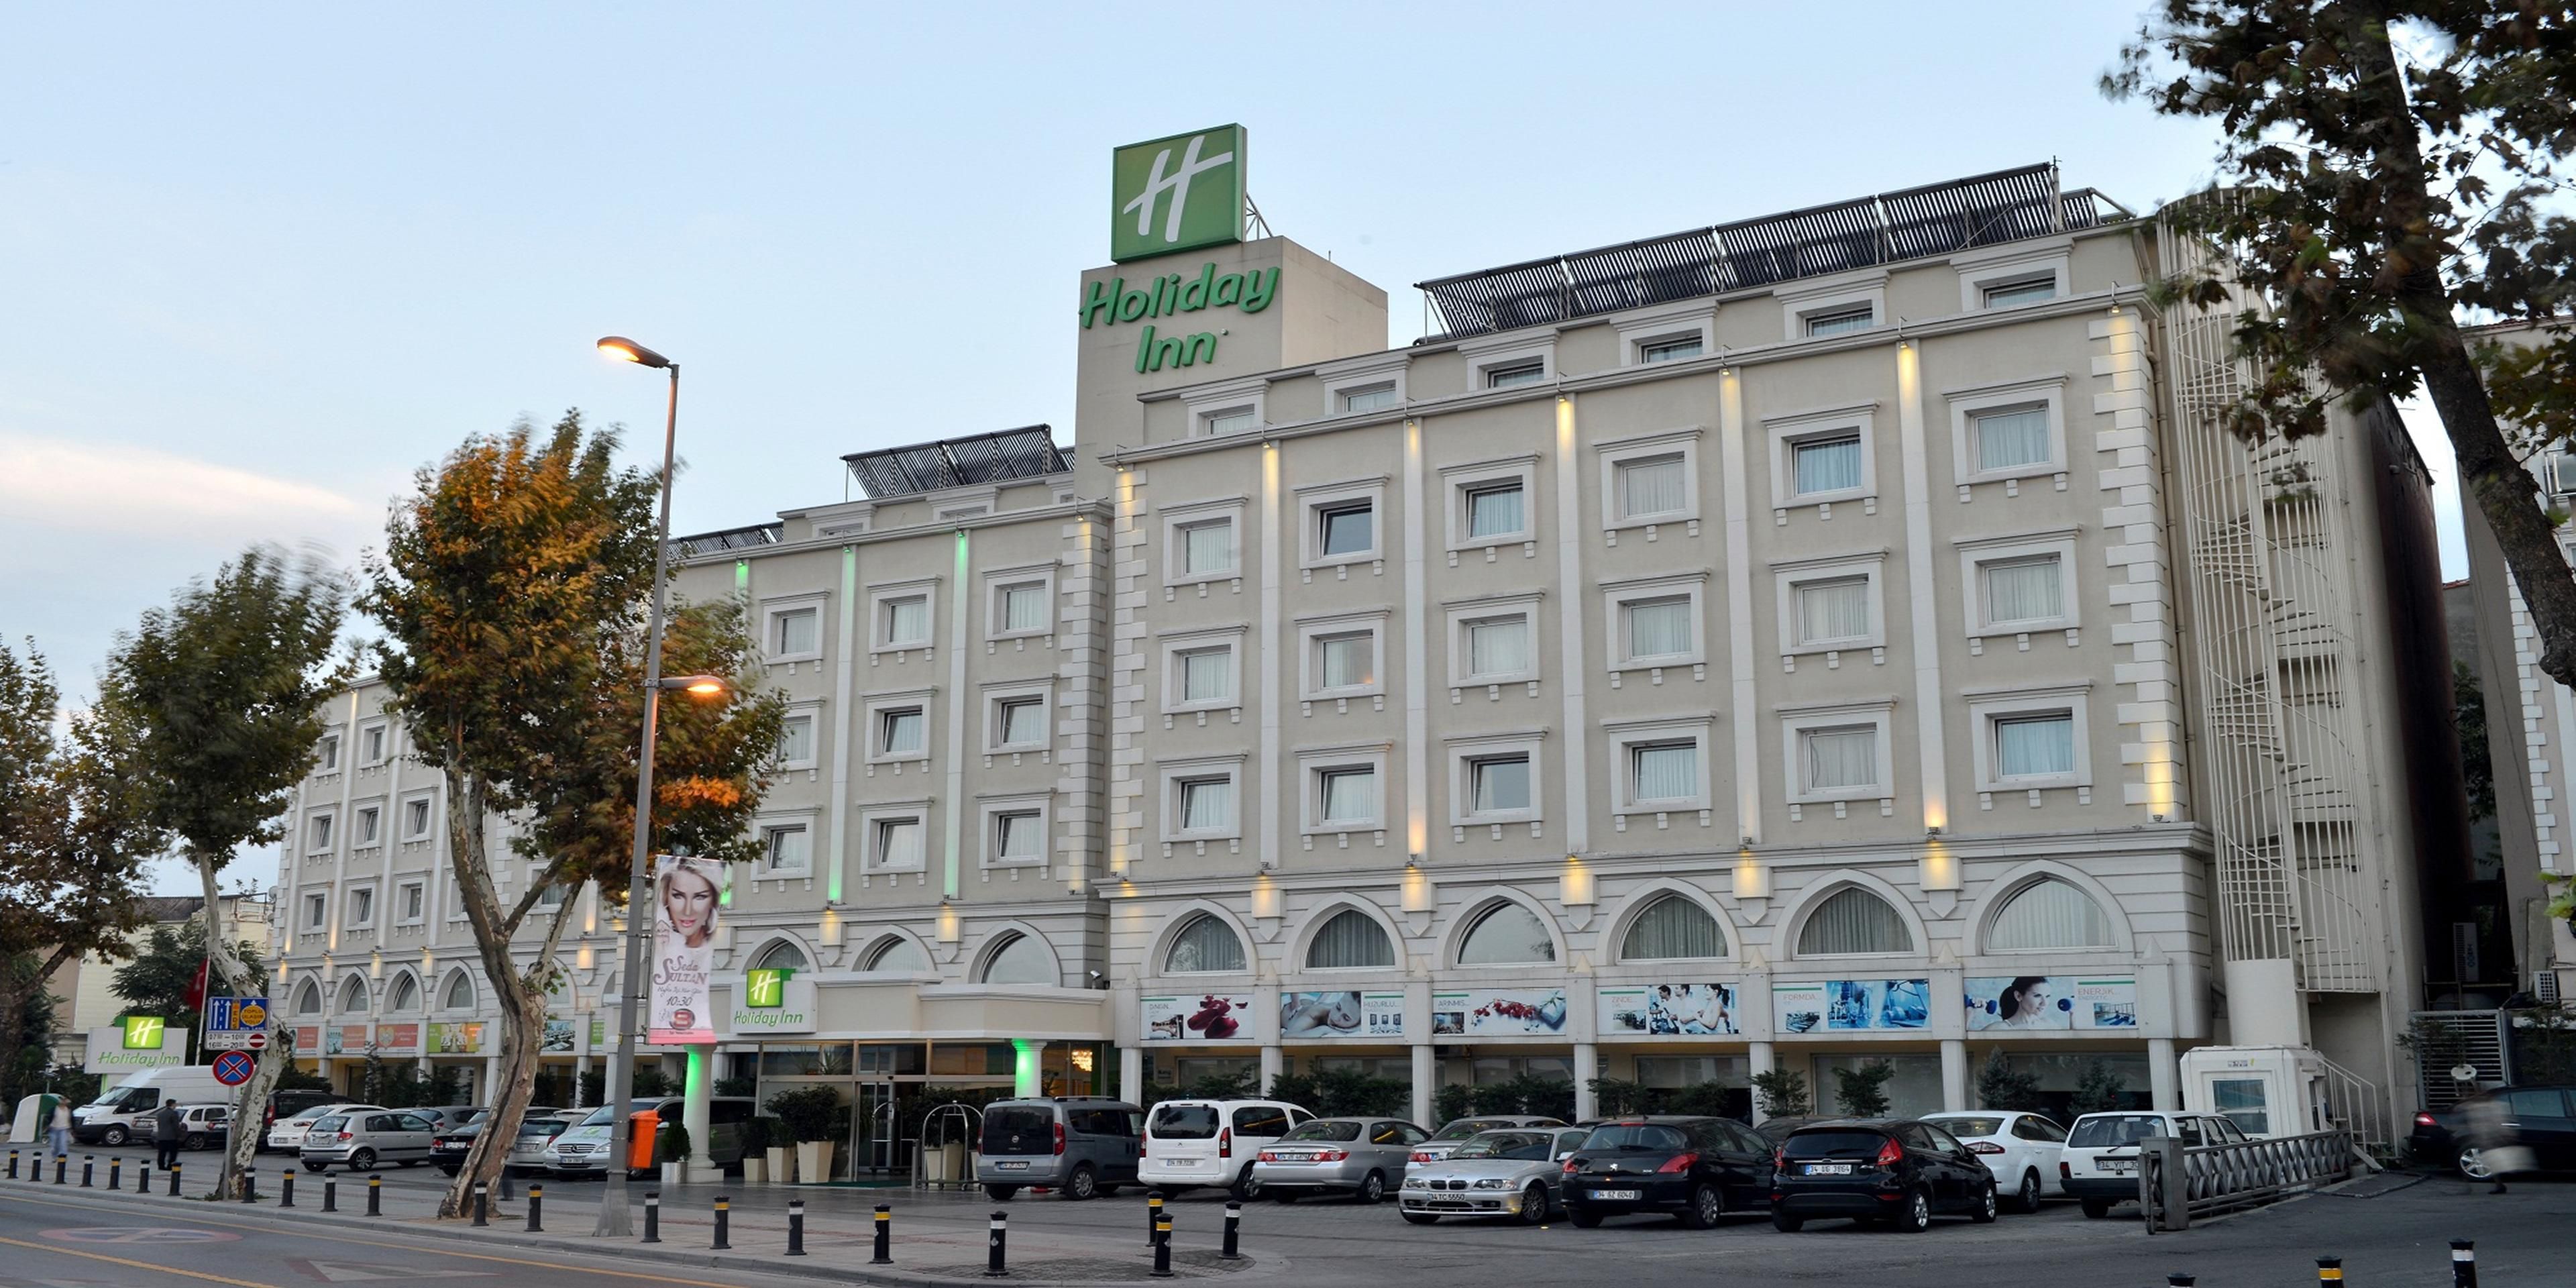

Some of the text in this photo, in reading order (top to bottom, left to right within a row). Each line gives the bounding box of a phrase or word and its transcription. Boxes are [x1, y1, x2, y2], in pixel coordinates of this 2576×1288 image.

[1079, 262, 1281, 329] Holiday
[1135, 325, 1217, 373] Inn
[653, 958, 708, 985] SULTAN
[671, 955, 699, 971] Seda
[666, 996, 693, 1006] 10:30
[734, 1010, 803, 1027] Holiday Inn
[97, 1051, 180, 1067] Holiday Inn
